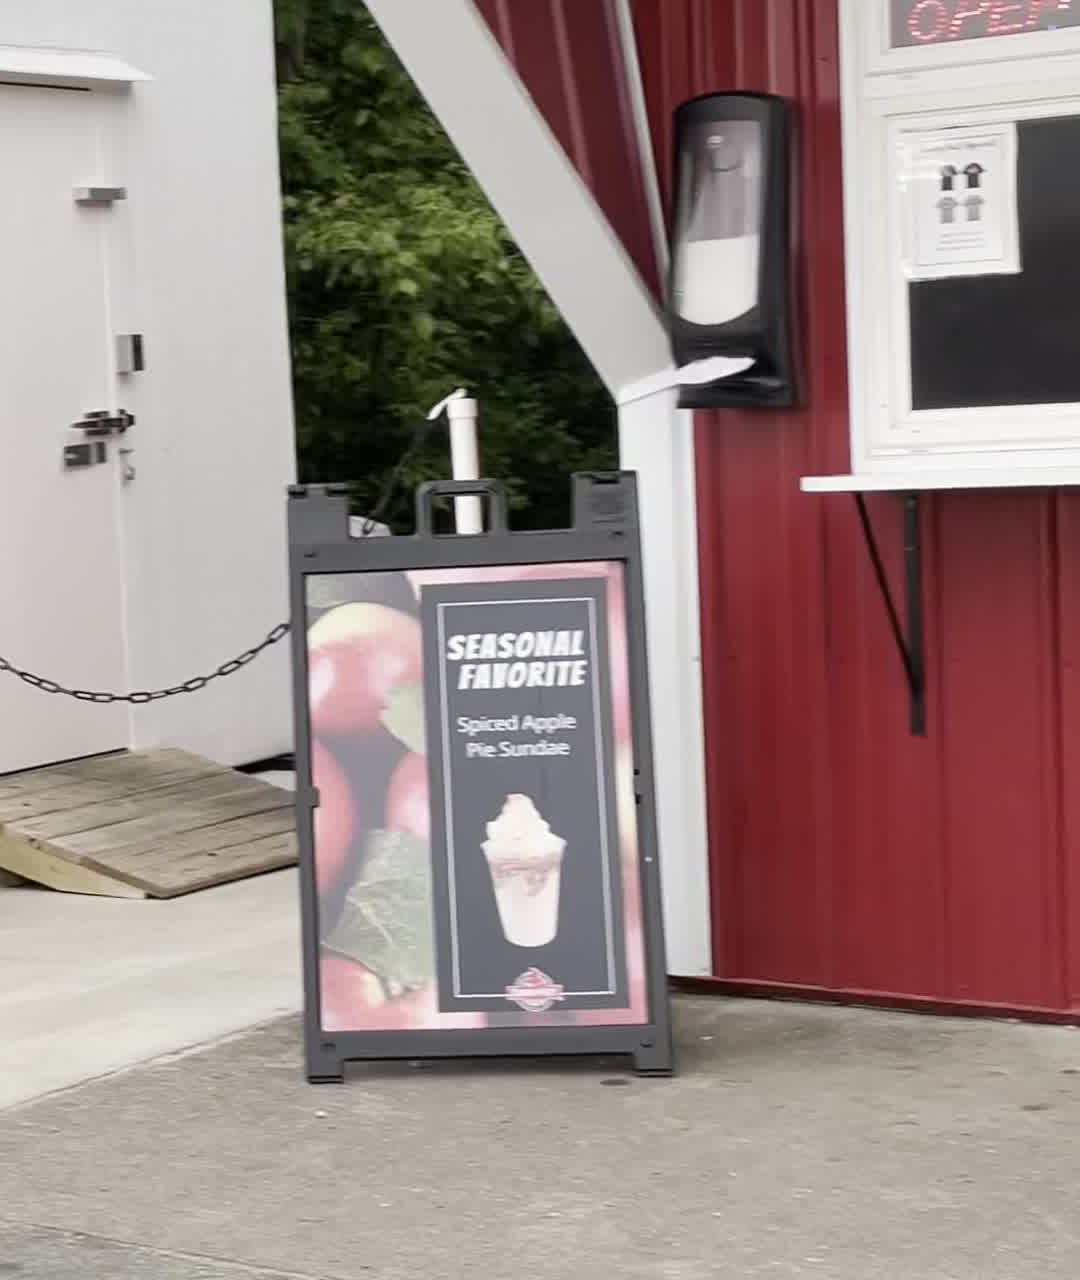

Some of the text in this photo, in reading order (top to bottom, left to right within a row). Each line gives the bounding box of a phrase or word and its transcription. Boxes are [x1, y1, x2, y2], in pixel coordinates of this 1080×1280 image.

[447, 630, 585, 660] SEASONAL
[457, 660, 587, 690] FAVORITE
[457, 714, 577, 736] Spiced Apple
[466, 740, 571, 758] Pie Sundae
